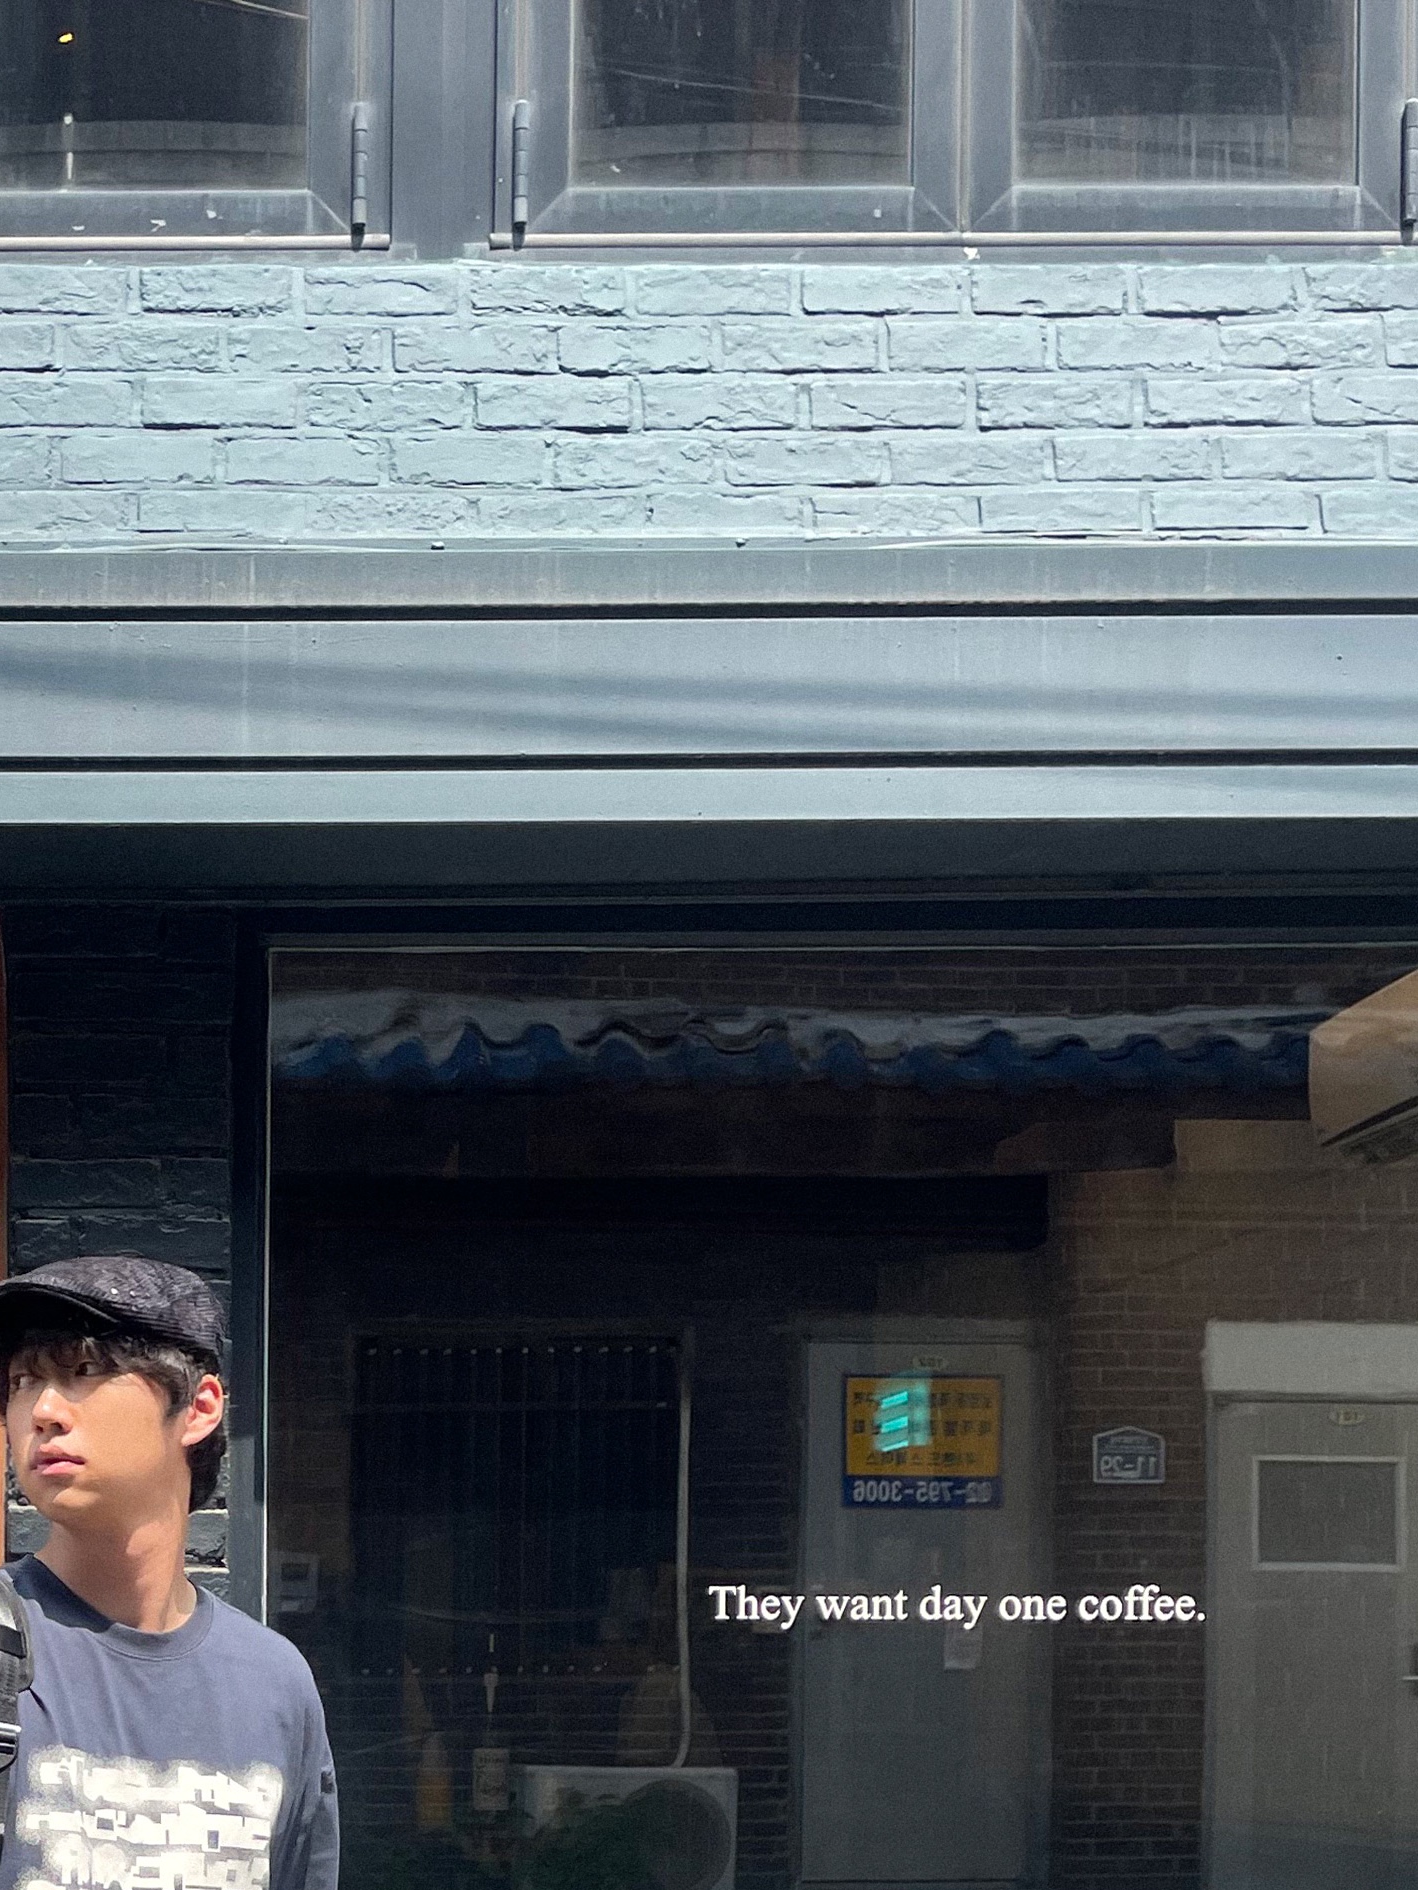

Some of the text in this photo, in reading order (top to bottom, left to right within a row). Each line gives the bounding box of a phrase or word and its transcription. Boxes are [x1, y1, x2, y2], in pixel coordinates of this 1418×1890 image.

[707, 1584, 1207, 1630] They want day one coffee.
